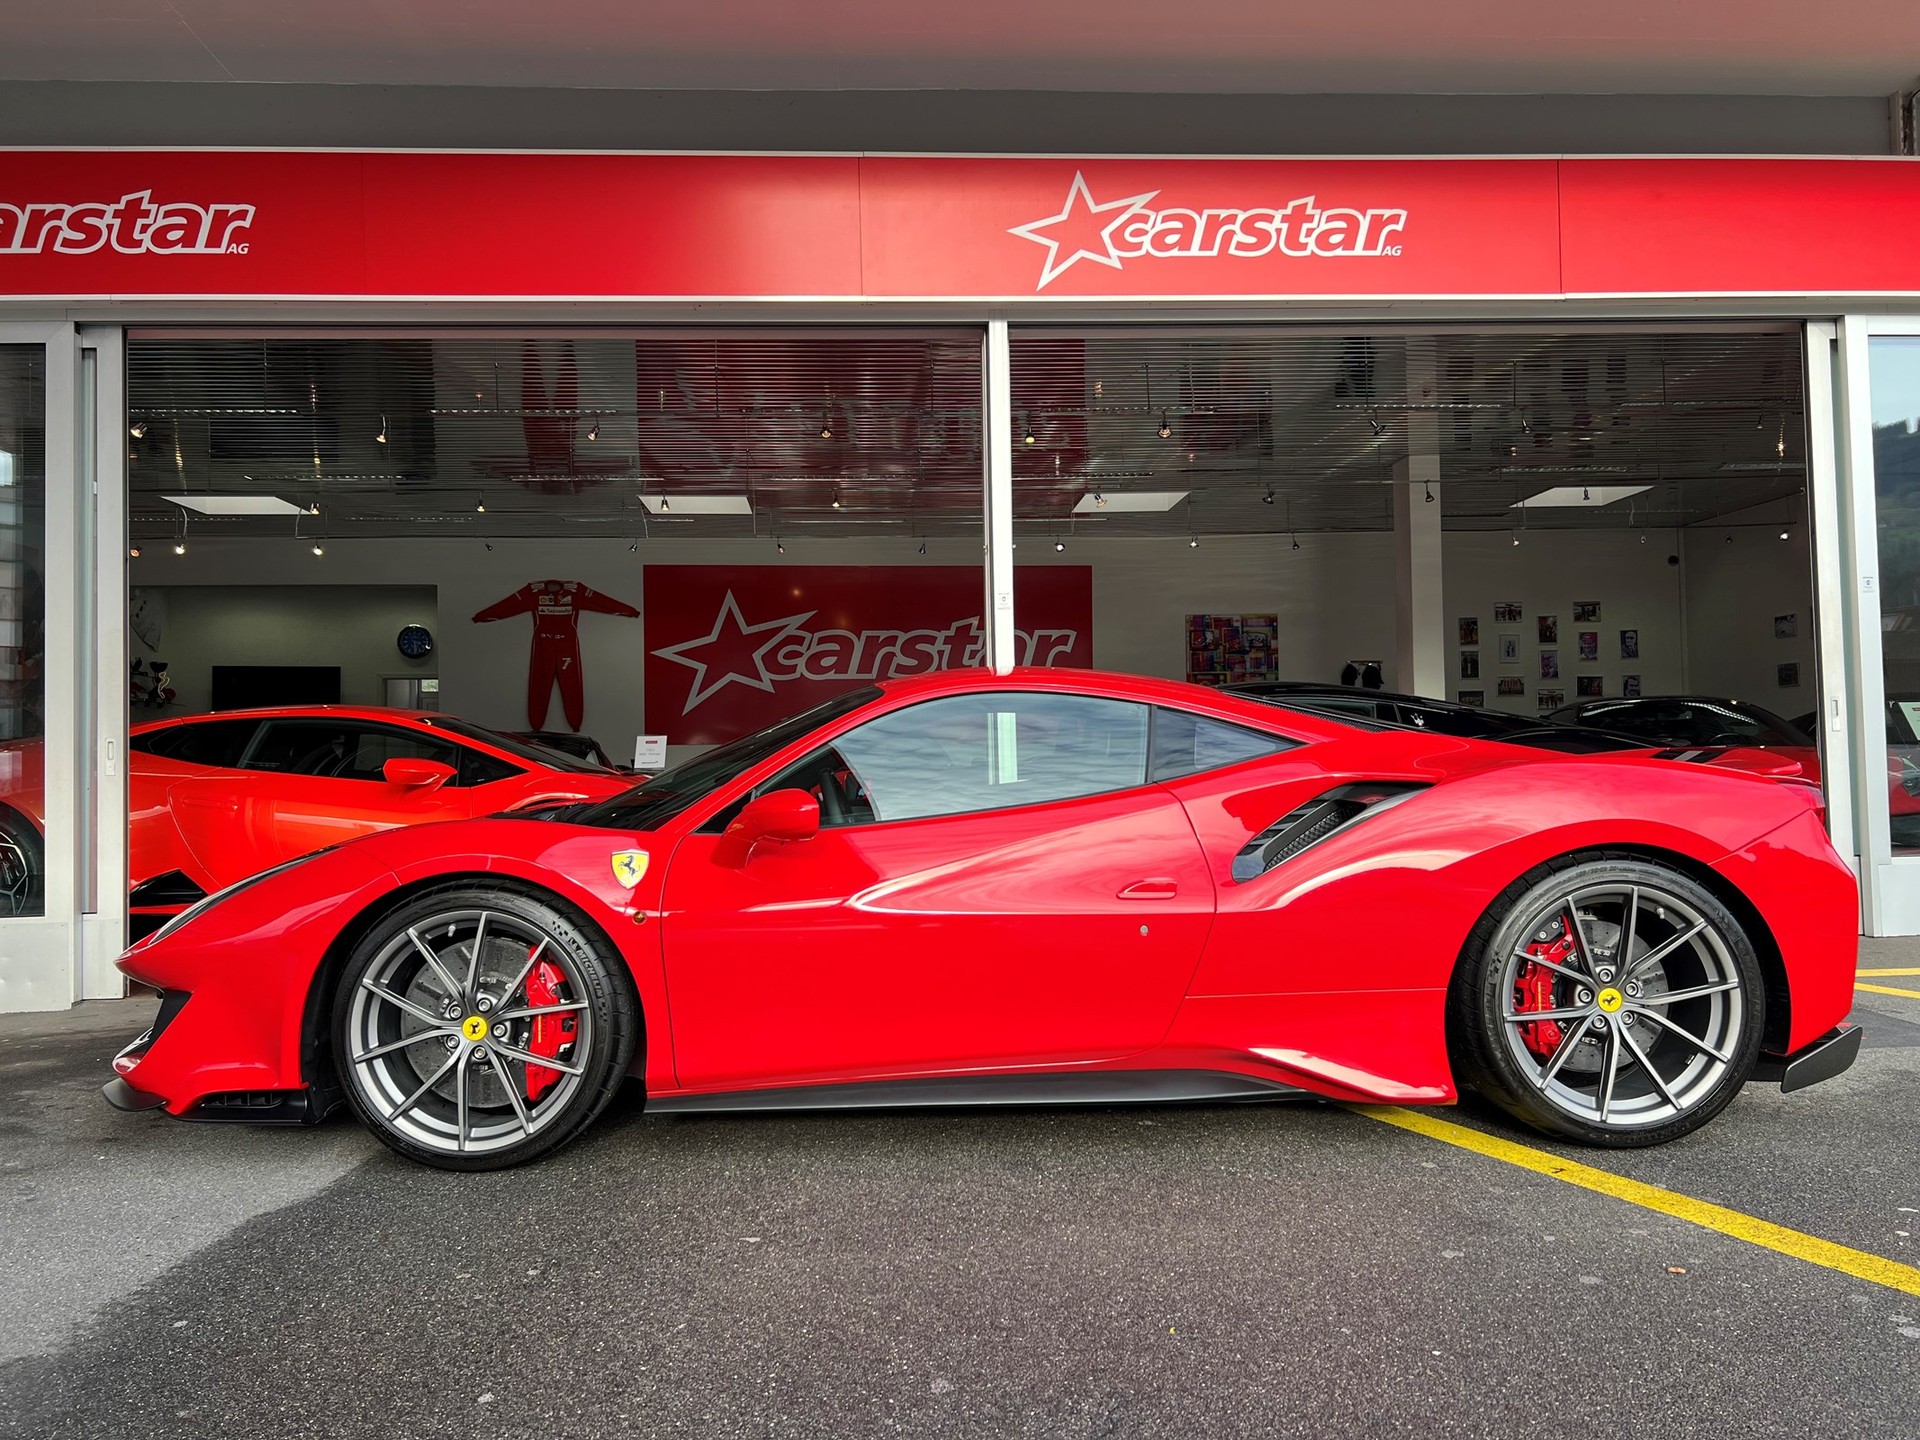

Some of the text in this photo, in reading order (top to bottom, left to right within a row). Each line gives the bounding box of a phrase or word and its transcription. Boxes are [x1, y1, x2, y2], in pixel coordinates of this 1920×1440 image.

[1104, 195, 1408, 257] carstar AG
[226, 243, 250, 255] AG
[561, 657, 573, 670] 7
[577, 949, 604, 998] MICHELIN
